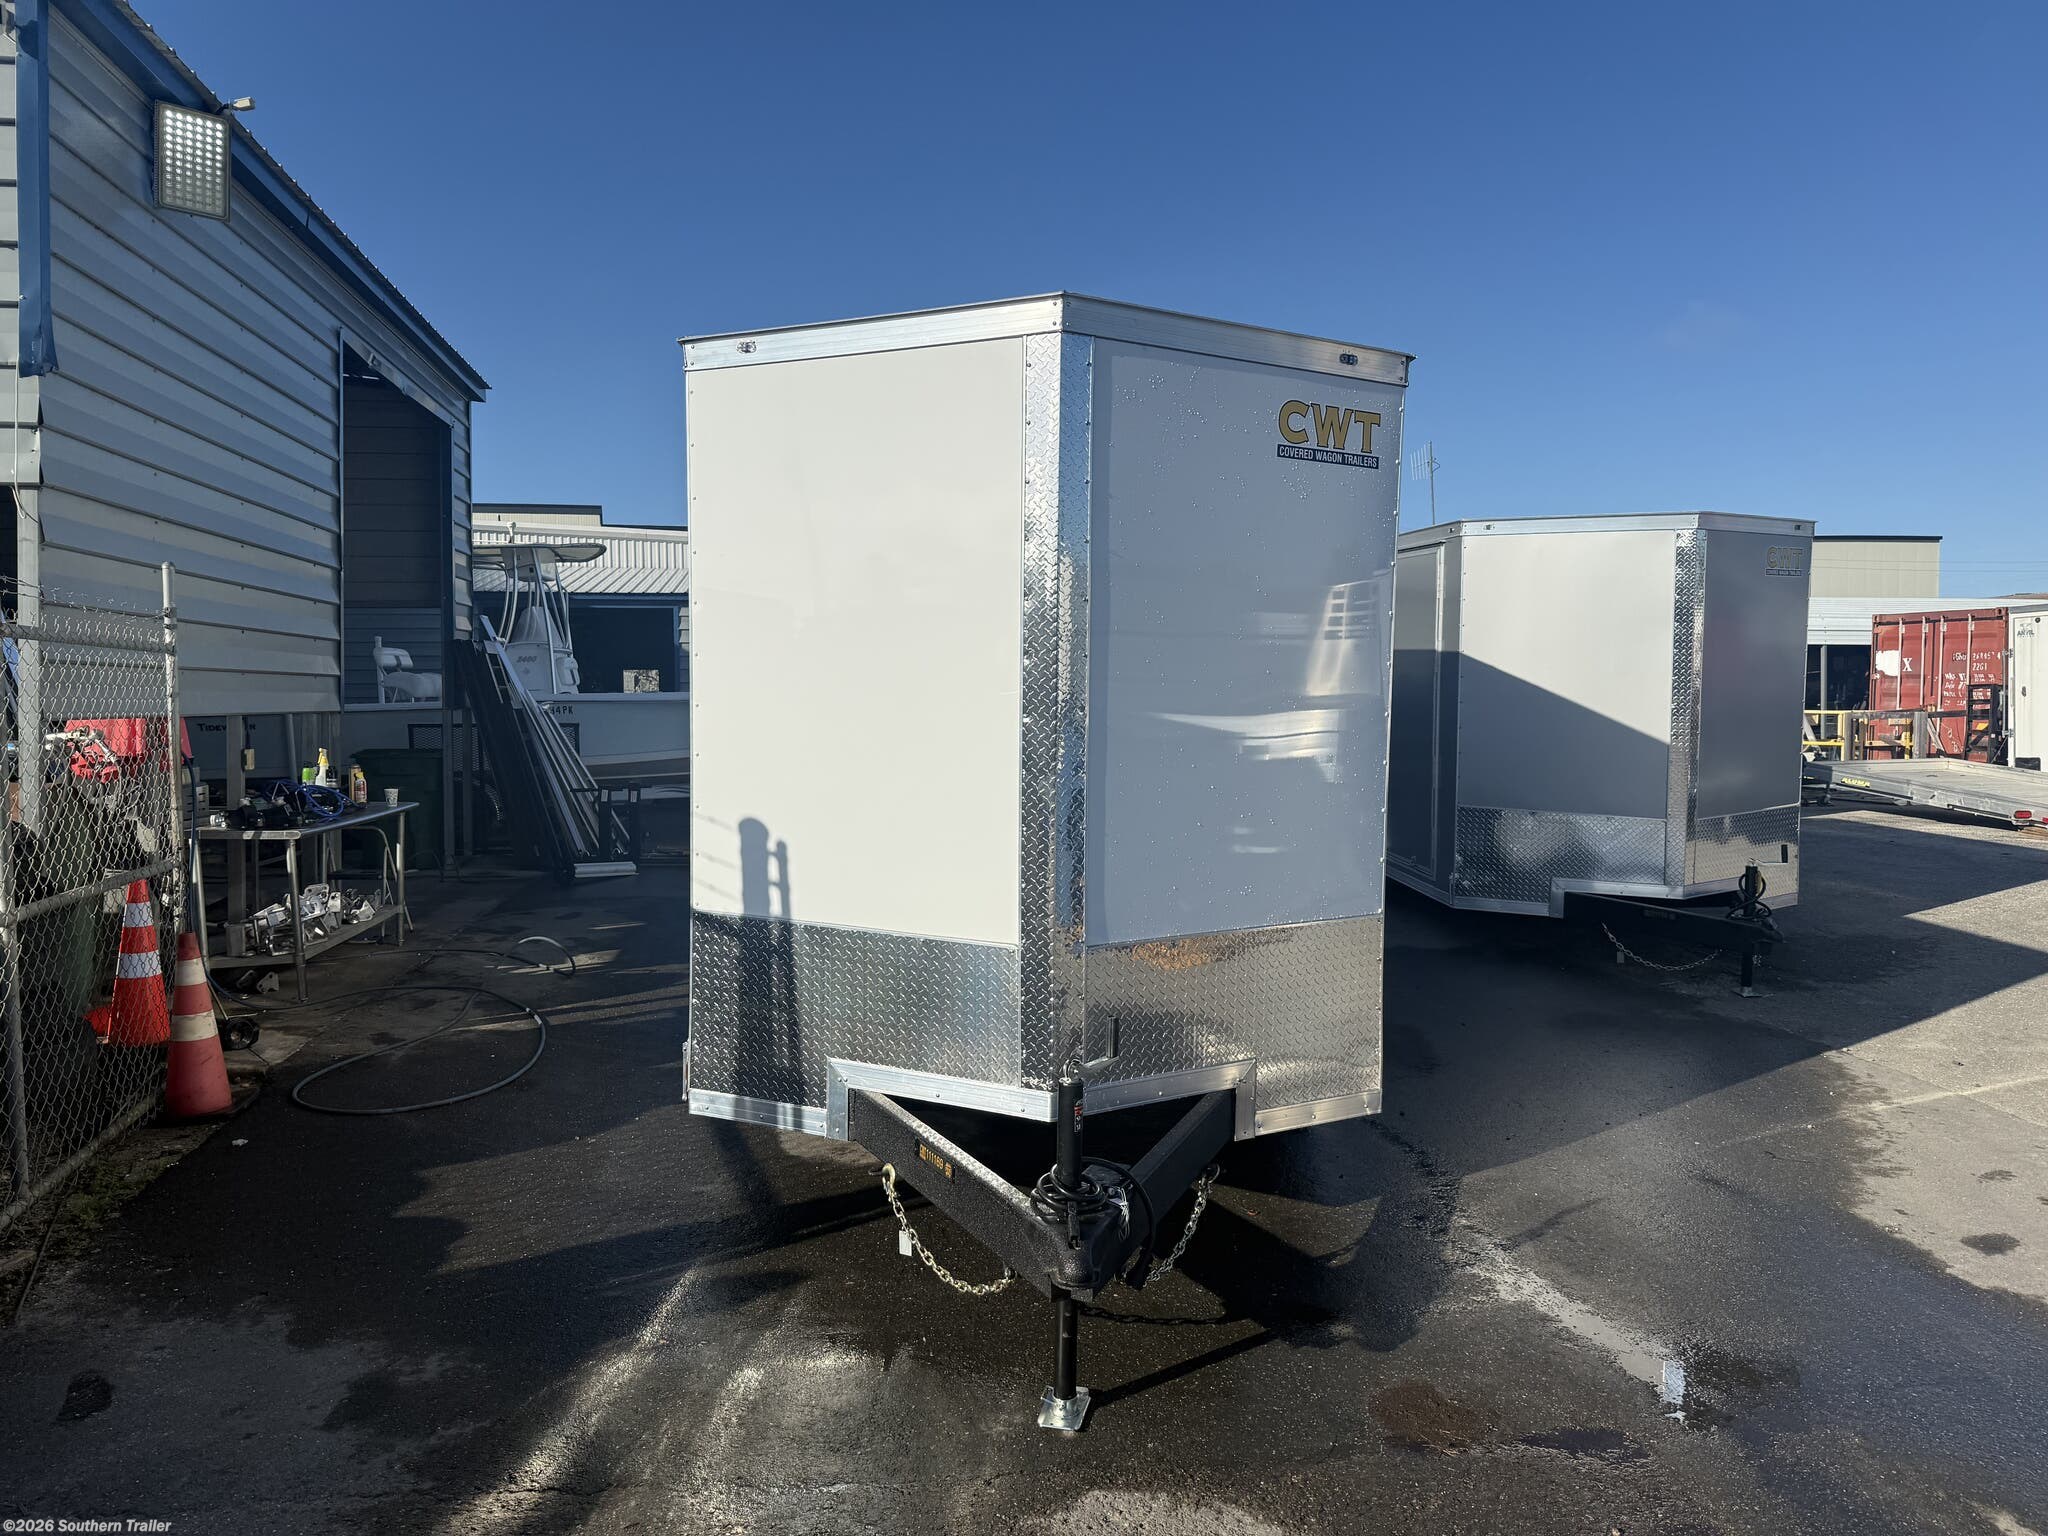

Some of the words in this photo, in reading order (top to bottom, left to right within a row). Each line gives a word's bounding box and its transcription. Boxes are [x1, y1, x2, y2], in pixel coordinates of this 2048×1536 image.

[1278, 400, 1381, 454] CWT
[1279, 446, 1314, 460] COVERED
[1315, 450, 1342, 464] WAGON
[1343, 454, 1378, 468] TRAILERS
[1767, 546, 1803, 570] CWT
